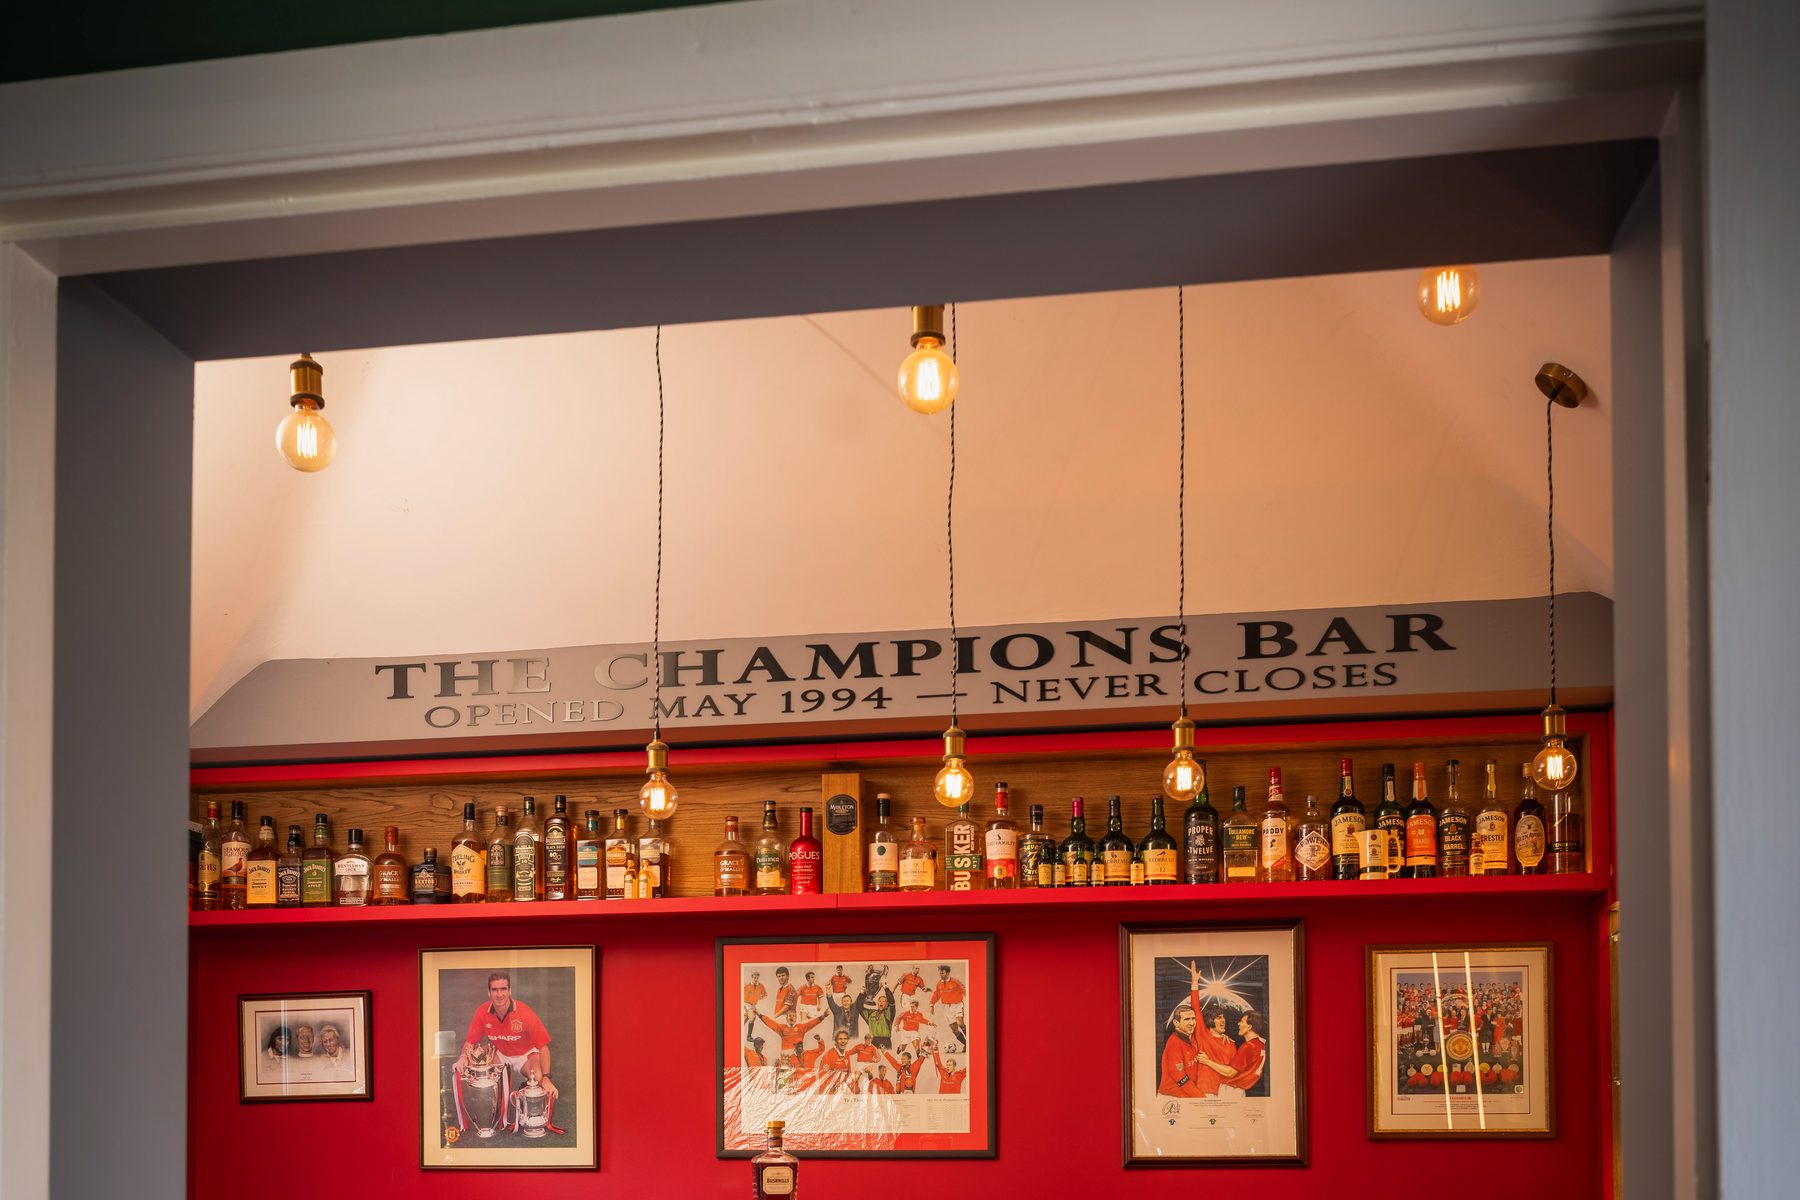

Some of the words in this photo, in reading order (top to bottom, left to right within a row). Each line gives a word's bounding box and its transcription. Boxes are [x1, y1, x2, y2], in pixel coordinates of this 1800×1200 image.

[374, 657, 552, 700] THE
[594, 624, 1191, 691] CHAMPIONS
[1236, 612, 1457, 660] BAR
[424, 699, 625, 729] OPENED
[648, 692, 757, 720] MAY
[780, 687, 893, 714] 1994
[991, 673, 1168, 704] NEVER
[1194, 662, 1398, 695] CLOSES
[1439, 816, 1468, 827] JAMESON
[1478, 815, 1505, 824] JAMESON
[1188, 825, 1213, 837] PROPER
[1262, 827, 1284, 835] PADDY
[1189, 846, 1213, 855] TWELVE
[953, 824, 971, 891] BUSKER
